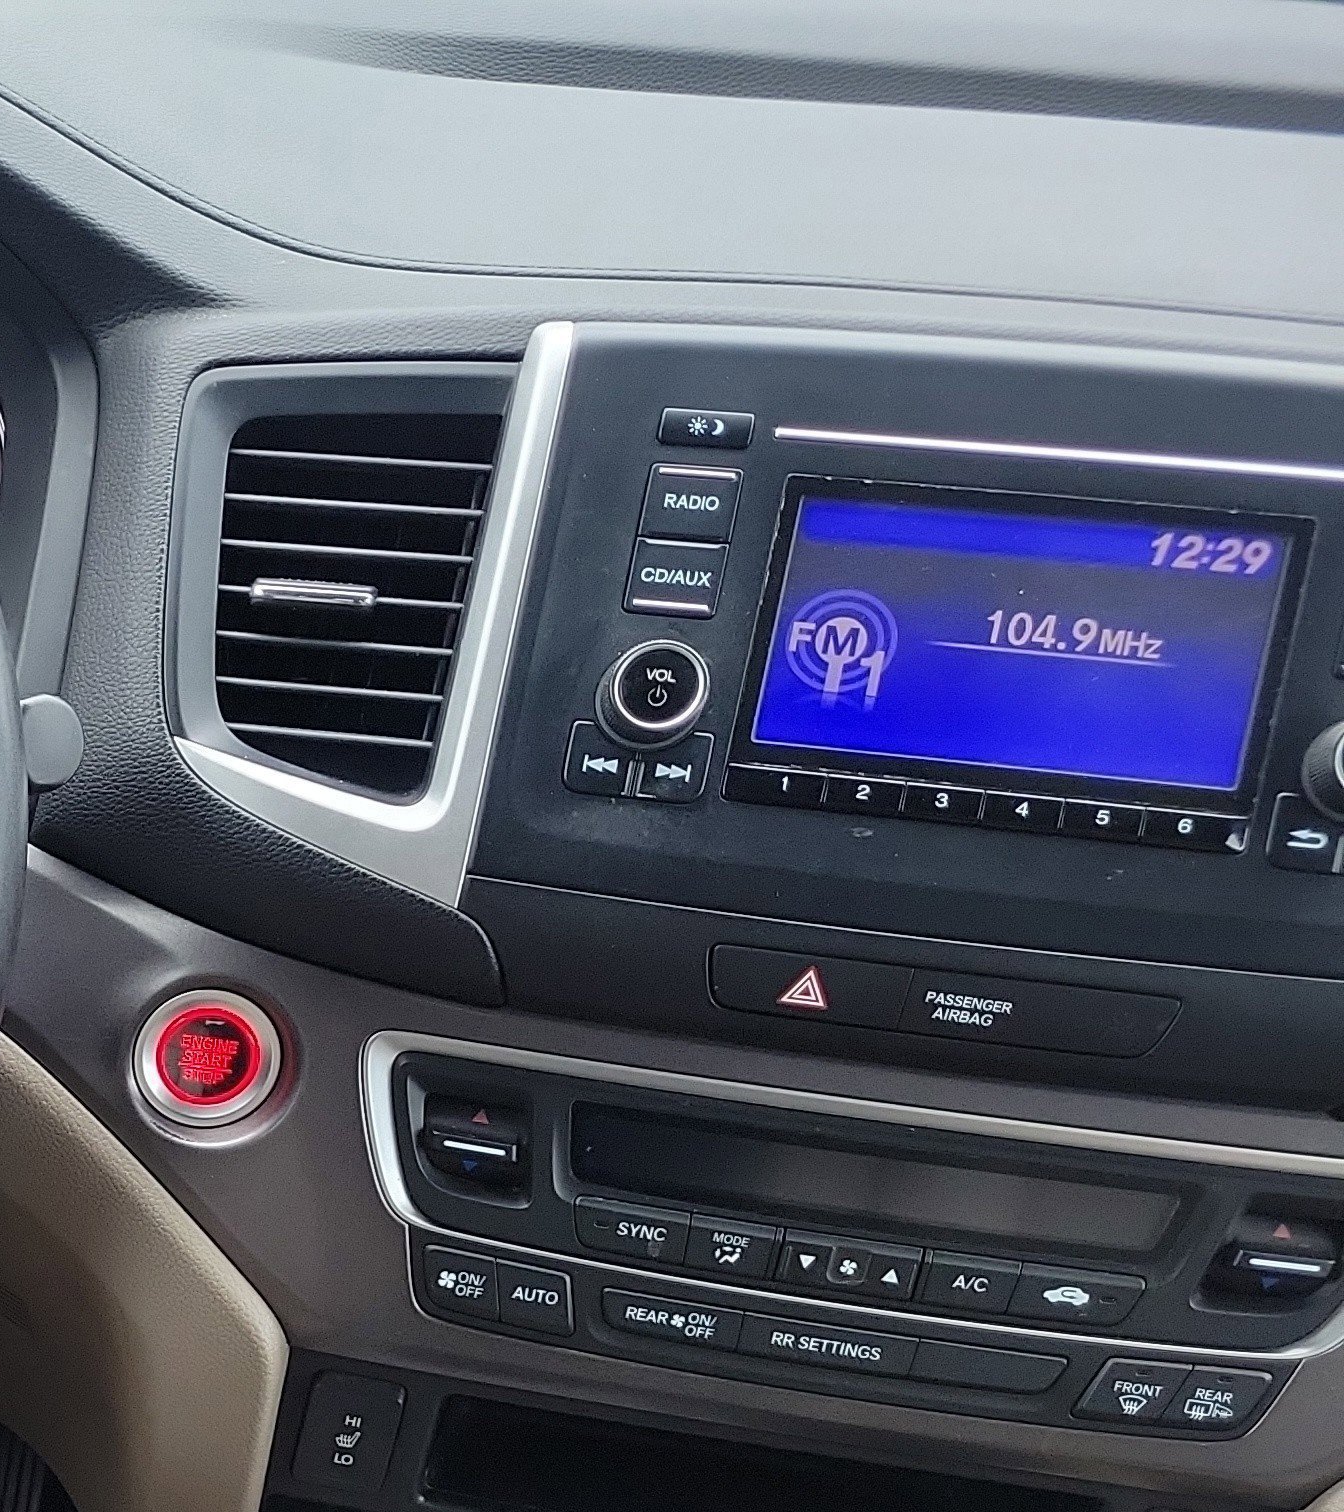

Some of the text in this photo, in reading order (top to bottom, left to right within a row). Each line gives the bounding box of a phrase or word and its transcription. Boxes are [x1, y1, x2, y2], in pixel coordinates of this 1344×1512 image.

[663, 493, 720, 511] RADIO
[1150, 532, 1272, 575] 12:29
[640, 567, 712, 588] CD/AUX
[646, 668, 676, 684] VOL
[781, 775, 789, 792] 1
[856, 784, 871, 800] 2
[935, 792, 949, 808] 3
[1015, 801, 1030, 817] 4
[1096, 809, 1110, 826] 5
[1177, 818, 1192, 834] 6
[924, 990, 1013, 1015] PASSENGER
[931, 1007, 994, 1027] AIRBAG
[181, 1034, 240, 1055] ENGINE
[182, 1051, 233, 1068] START
[182, 1068, 225, 1085] STOP
[616, 1221, 668, 1242] SYNC
[712, 1231, 750, 1248] MODE
[454, 1284, 485, 1300] OFF
[952, 1274, 989, 1293] A/C
[511, 1286, 559, 1306] AUTO
[624, 1306, 669, 1326] REAR
[684, 1324, 716, 1340] OFF
[770, 1331, 882, 1361] RR SETTINGS
[1113, 1380, 1163, 1398] FRONT
[1194, 1387, 1233, 1405] REAR
[344, 1415, 362, 1428] HI
[333, 1452, 354, 1466] LO
